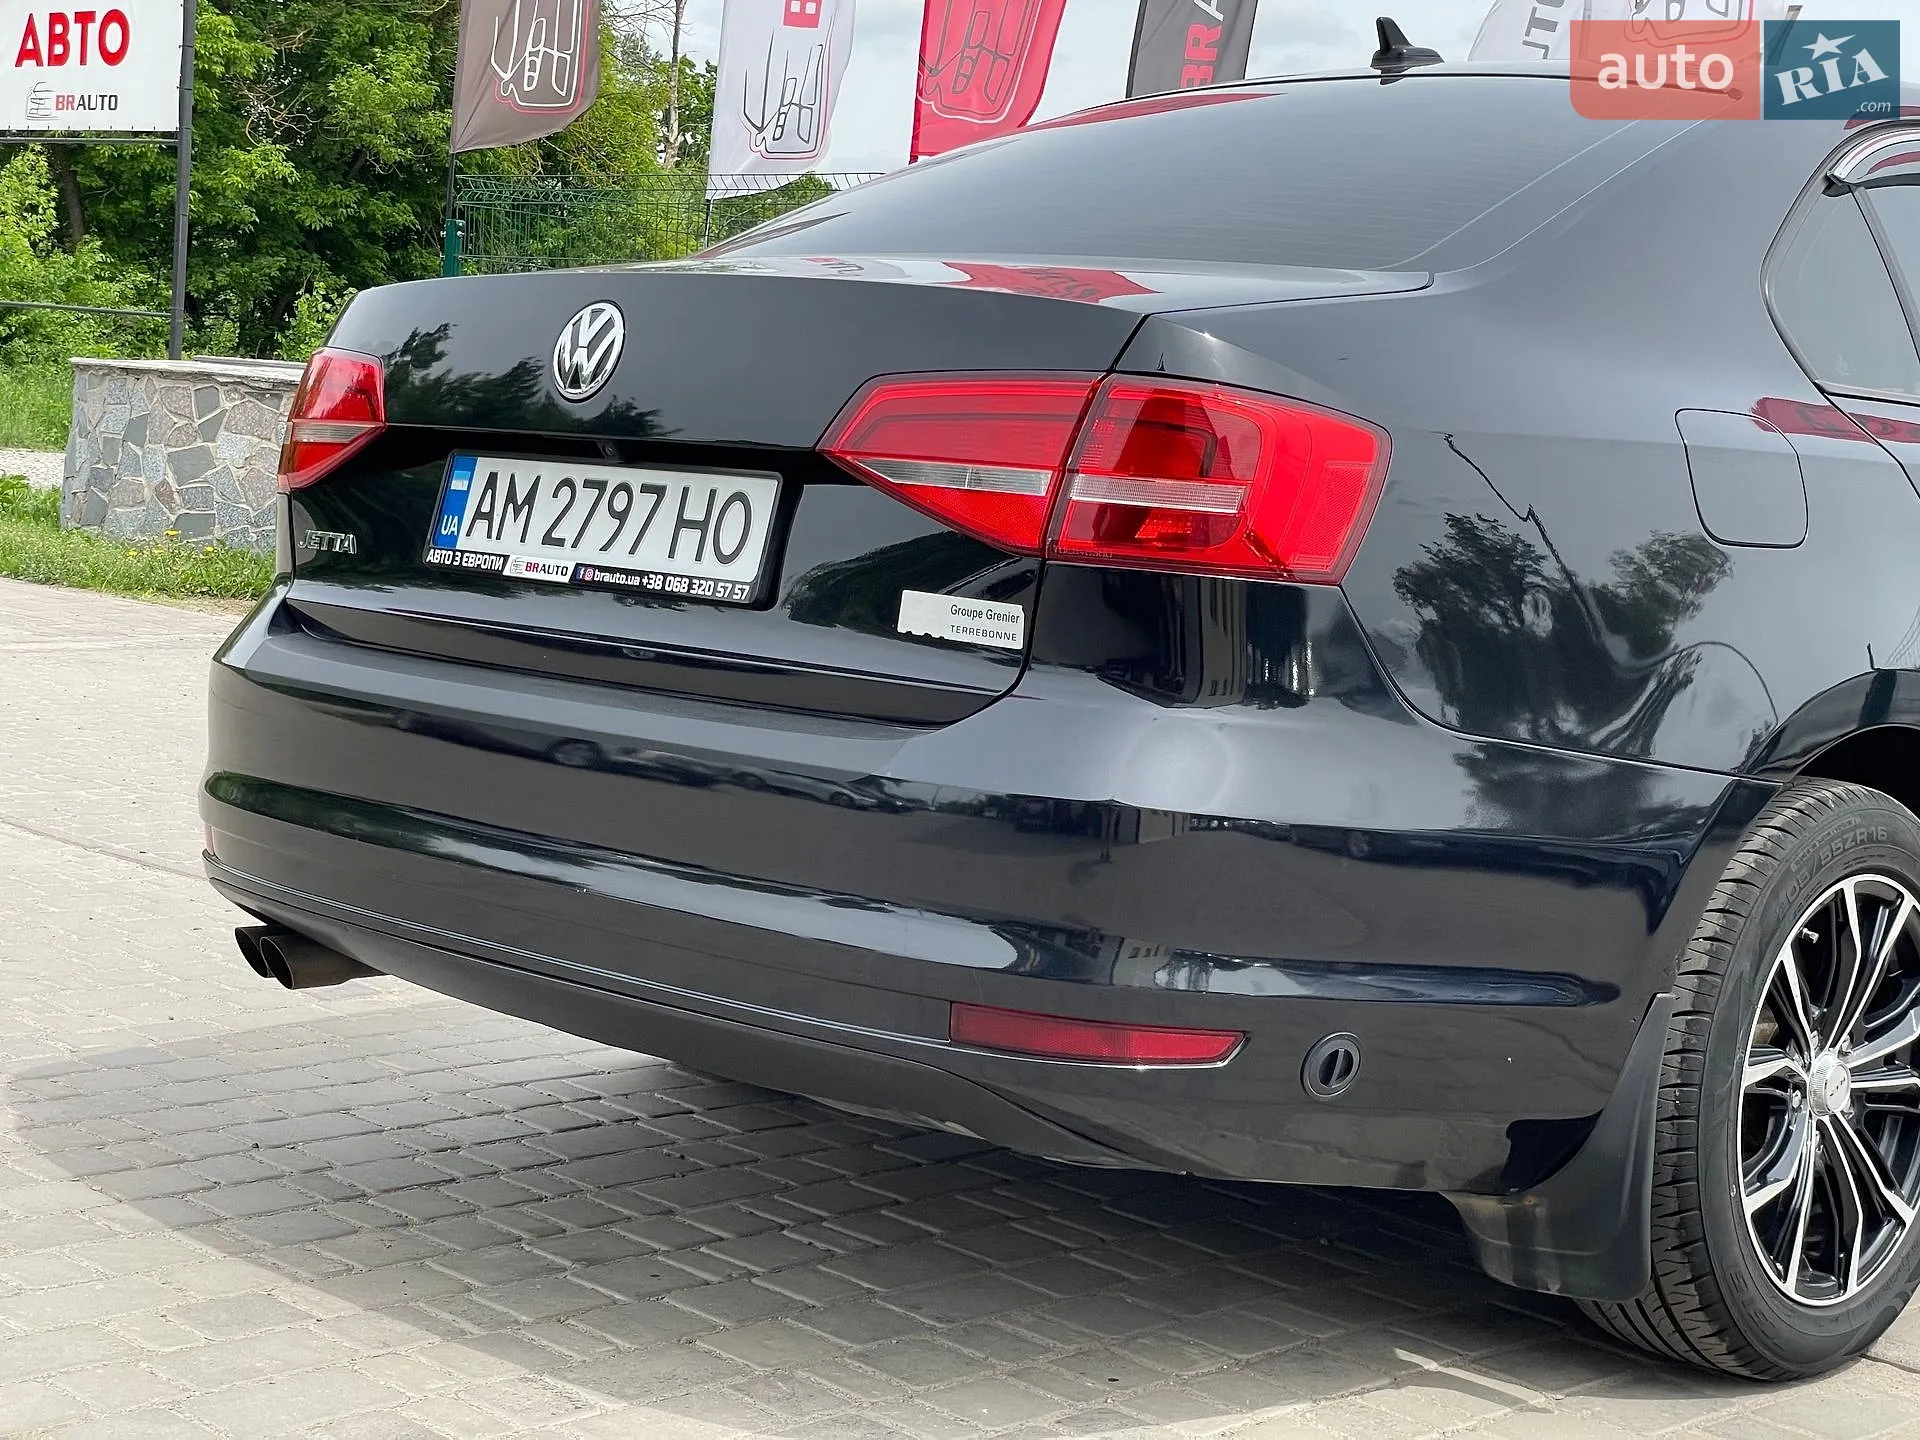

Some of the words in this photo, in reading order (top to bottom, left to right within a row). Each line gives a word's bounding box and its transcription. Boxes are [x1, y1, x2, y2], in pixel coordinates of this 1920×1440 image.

[14, 9, 130, 68] АВТО
[55, 94, 118, 111] BRAUTO
[441, 515, 459, 536] UA
[465, 471, 543, 544] AM
[540, 476, 668, 556] 2797
[667, 486, 753, 566] HO
[297, 529, 357, 554] JETTA
[426, 549, 453, 565] АВТО
[524, 561, 569, 577] BRAUTO
[593, 573, 640, 586] brauto.ua
[641, 574, 664, 591] +38
[664, 576, 689, 593] 068
[689, 579, 715, 597] 320
[715, 582, 733, 599] 57
[732, 584, 750, 601] 57
[950, 604, 983, 621] Groupe
[985, 608, 1020, 624] Grenier
[950, 624, 1017, 642] TERREBONNE
